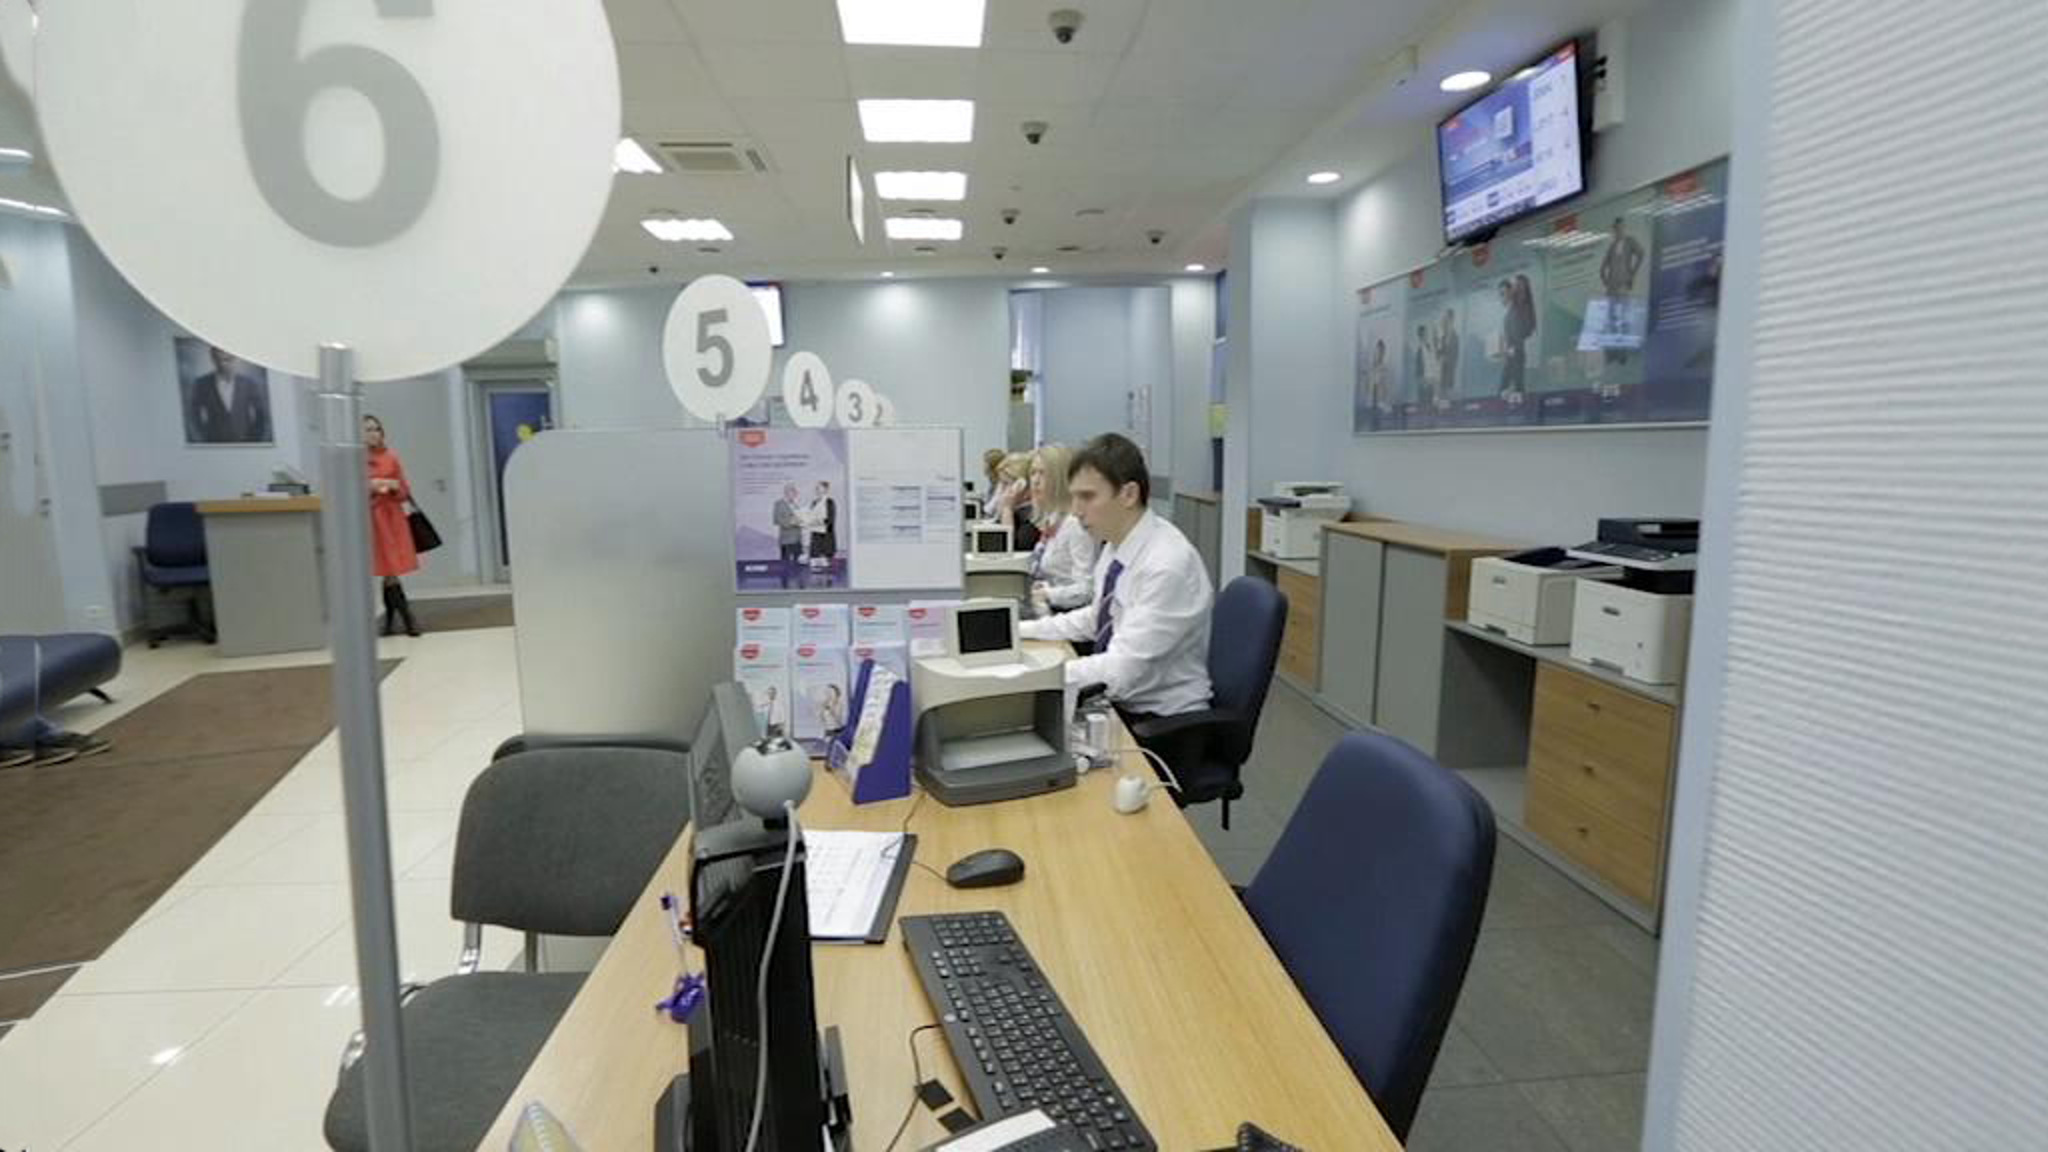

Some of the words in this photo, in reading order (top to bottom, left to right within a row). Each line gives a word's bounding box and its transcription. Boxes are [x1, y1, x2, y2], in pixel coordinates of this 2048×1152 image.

[236, 0, 441, 248] 6
[696, 308, 734, 387] 5
[800, 368, 817, 411] 4
[848, 391, 863, 423] 3
